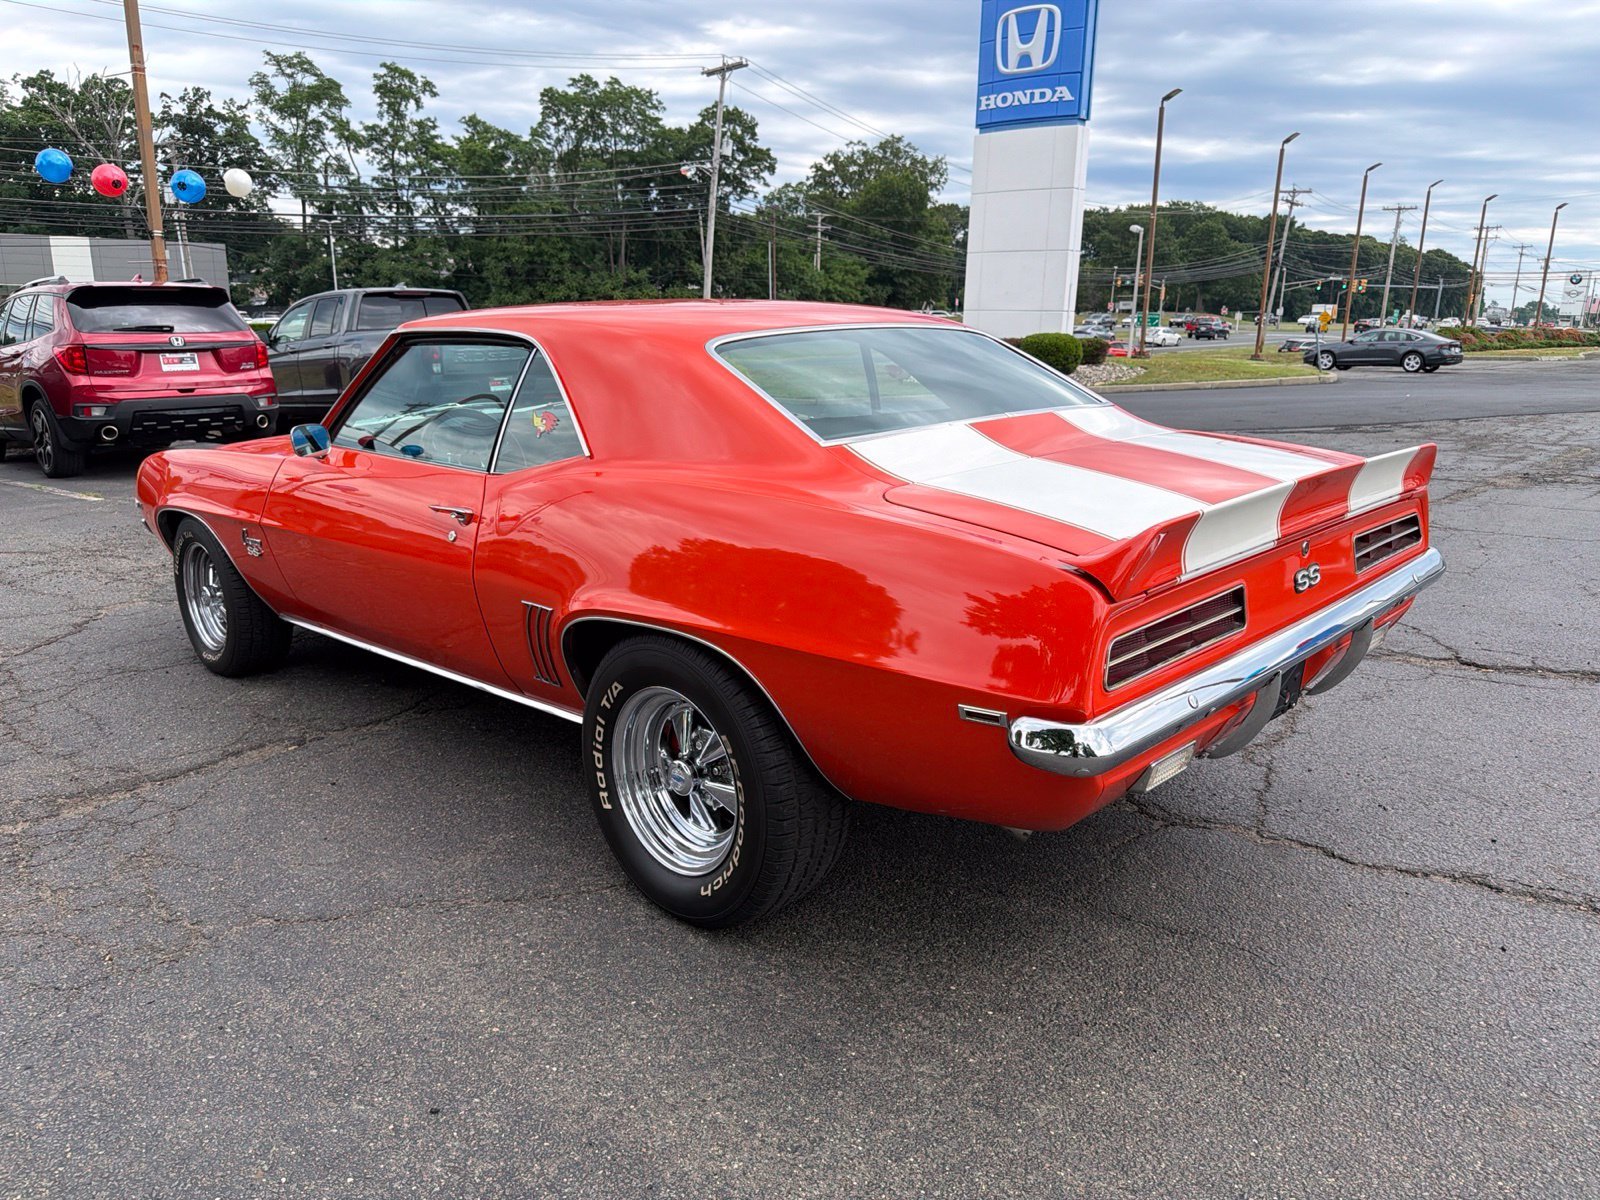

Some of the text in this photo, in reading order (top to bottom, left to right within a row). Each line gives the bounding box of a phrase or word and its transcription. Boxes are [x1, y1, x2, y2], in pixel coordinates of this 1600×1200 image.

[979, 86, 1074, 111] HONDA
[1294, 563, 1320, 593] SS
[592, 681, 624, 810] Radial T/A
